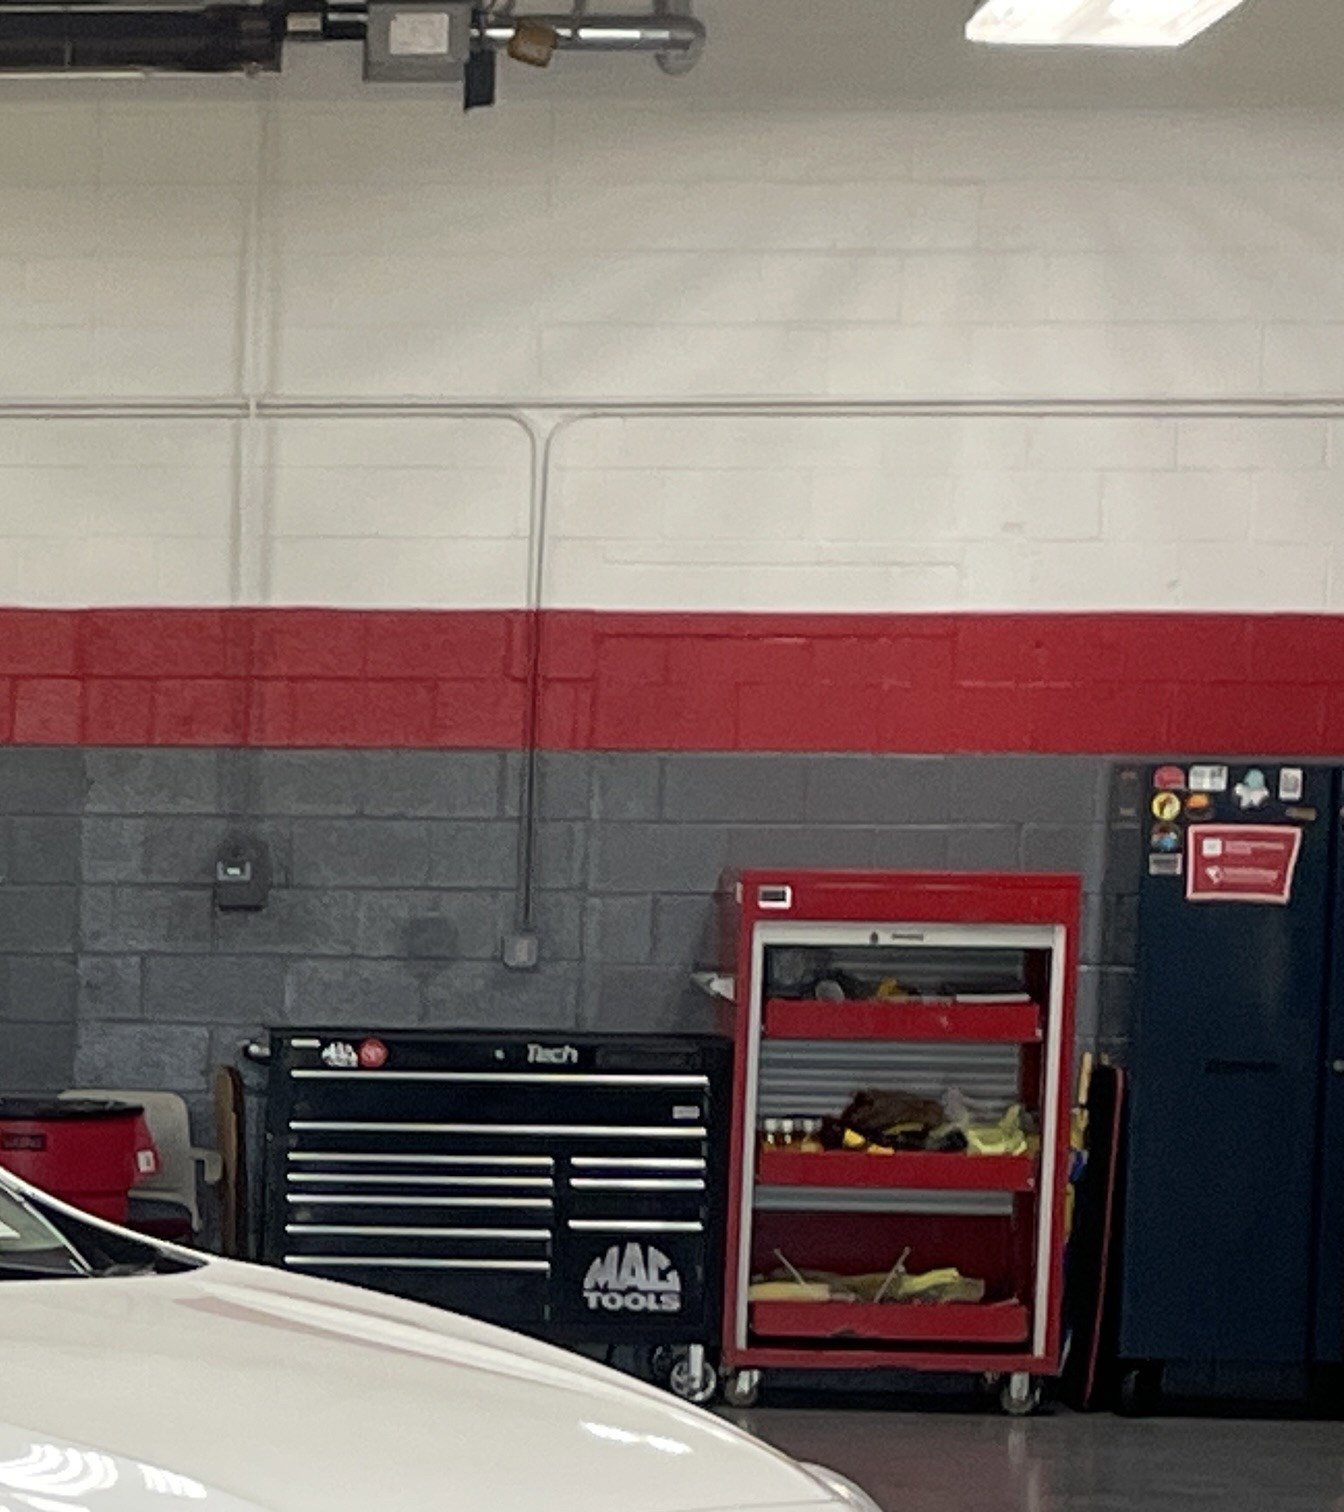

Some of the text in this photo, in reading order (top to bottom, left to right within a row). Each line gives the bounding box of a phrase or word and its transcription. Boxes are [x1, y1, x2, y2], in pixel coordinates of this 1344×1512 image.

[527, 1043, 579, 1064] Tech
[583, 1241, 681, 1291] MAC
[583, 1291, 681, 1311] TOOLS
